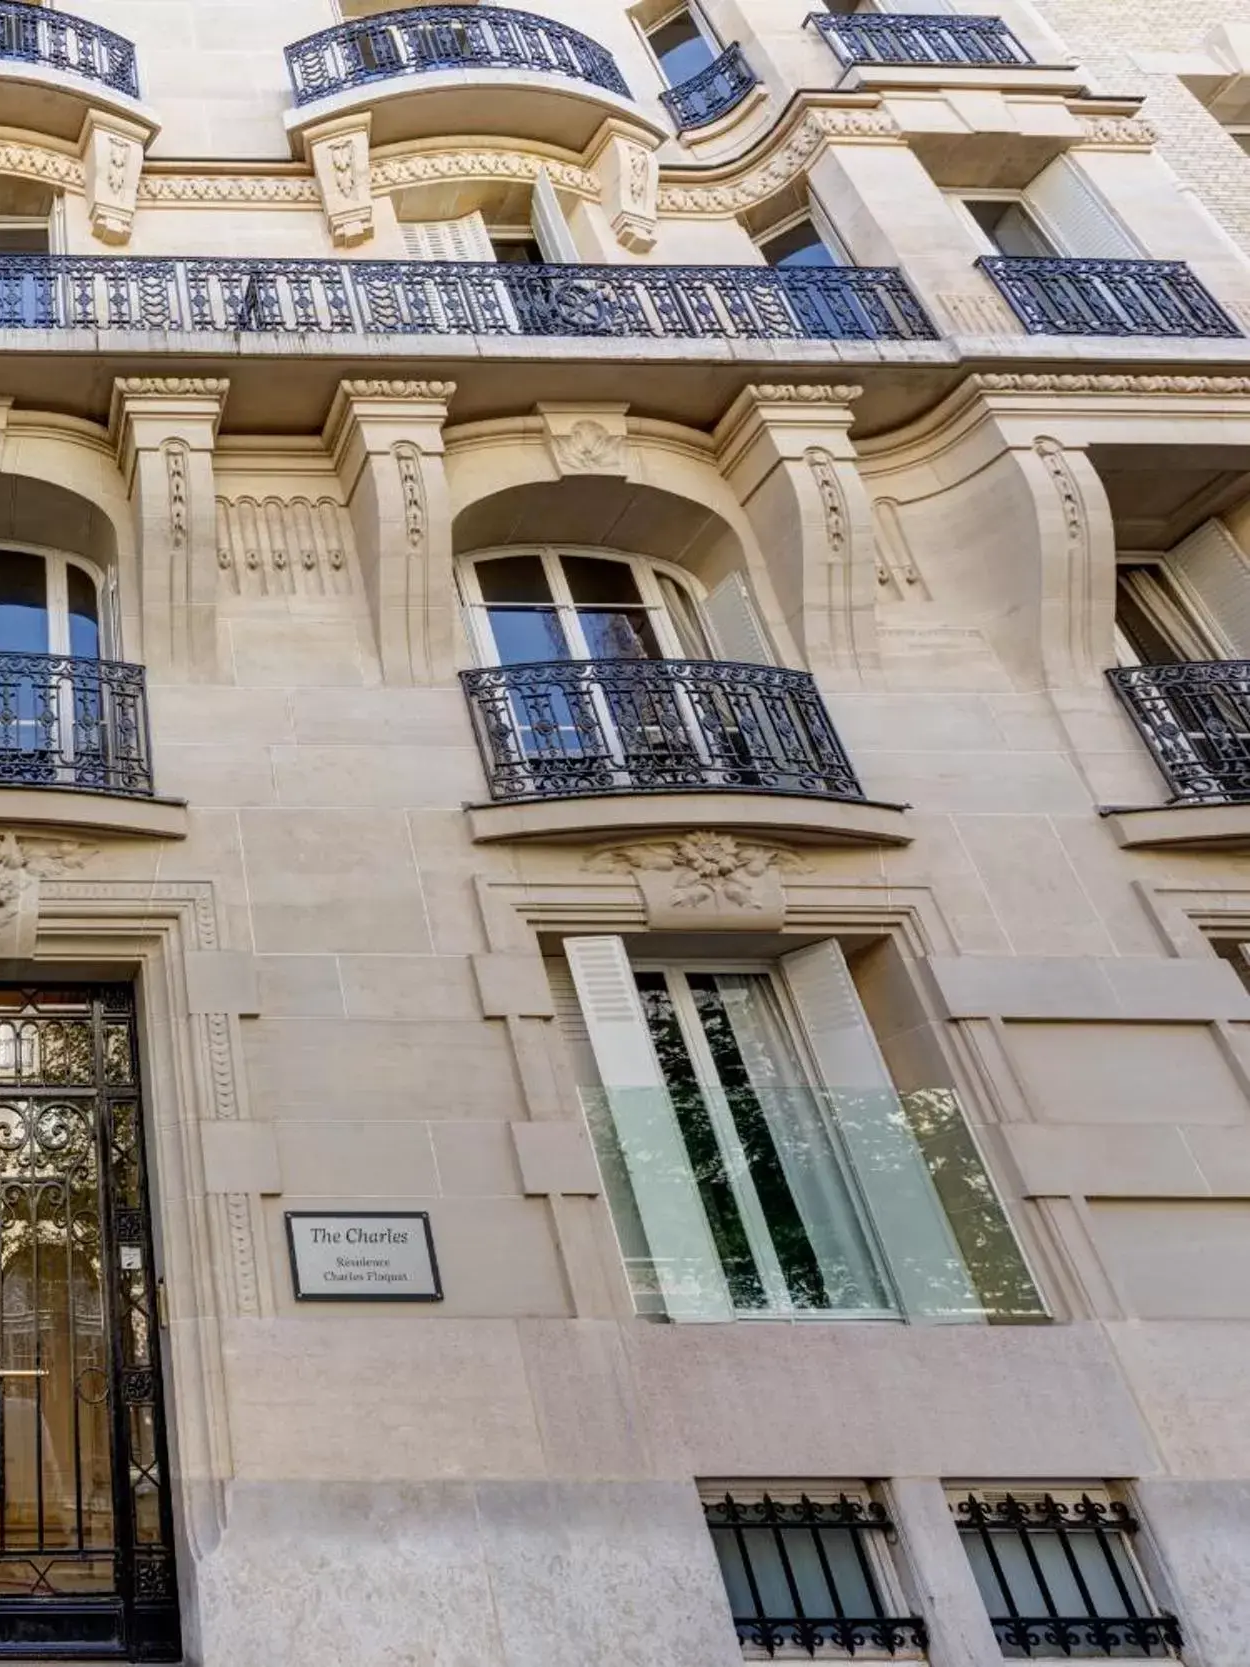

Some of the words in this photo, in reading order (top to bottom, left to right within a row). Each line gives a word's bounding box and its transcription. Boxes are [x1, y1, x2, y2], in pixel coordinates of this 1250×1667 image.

[310, 1228, 341, 1243] The
[346, 1228, 409, 1244] Charles
[323, 1271, 364, 1281] Charles
